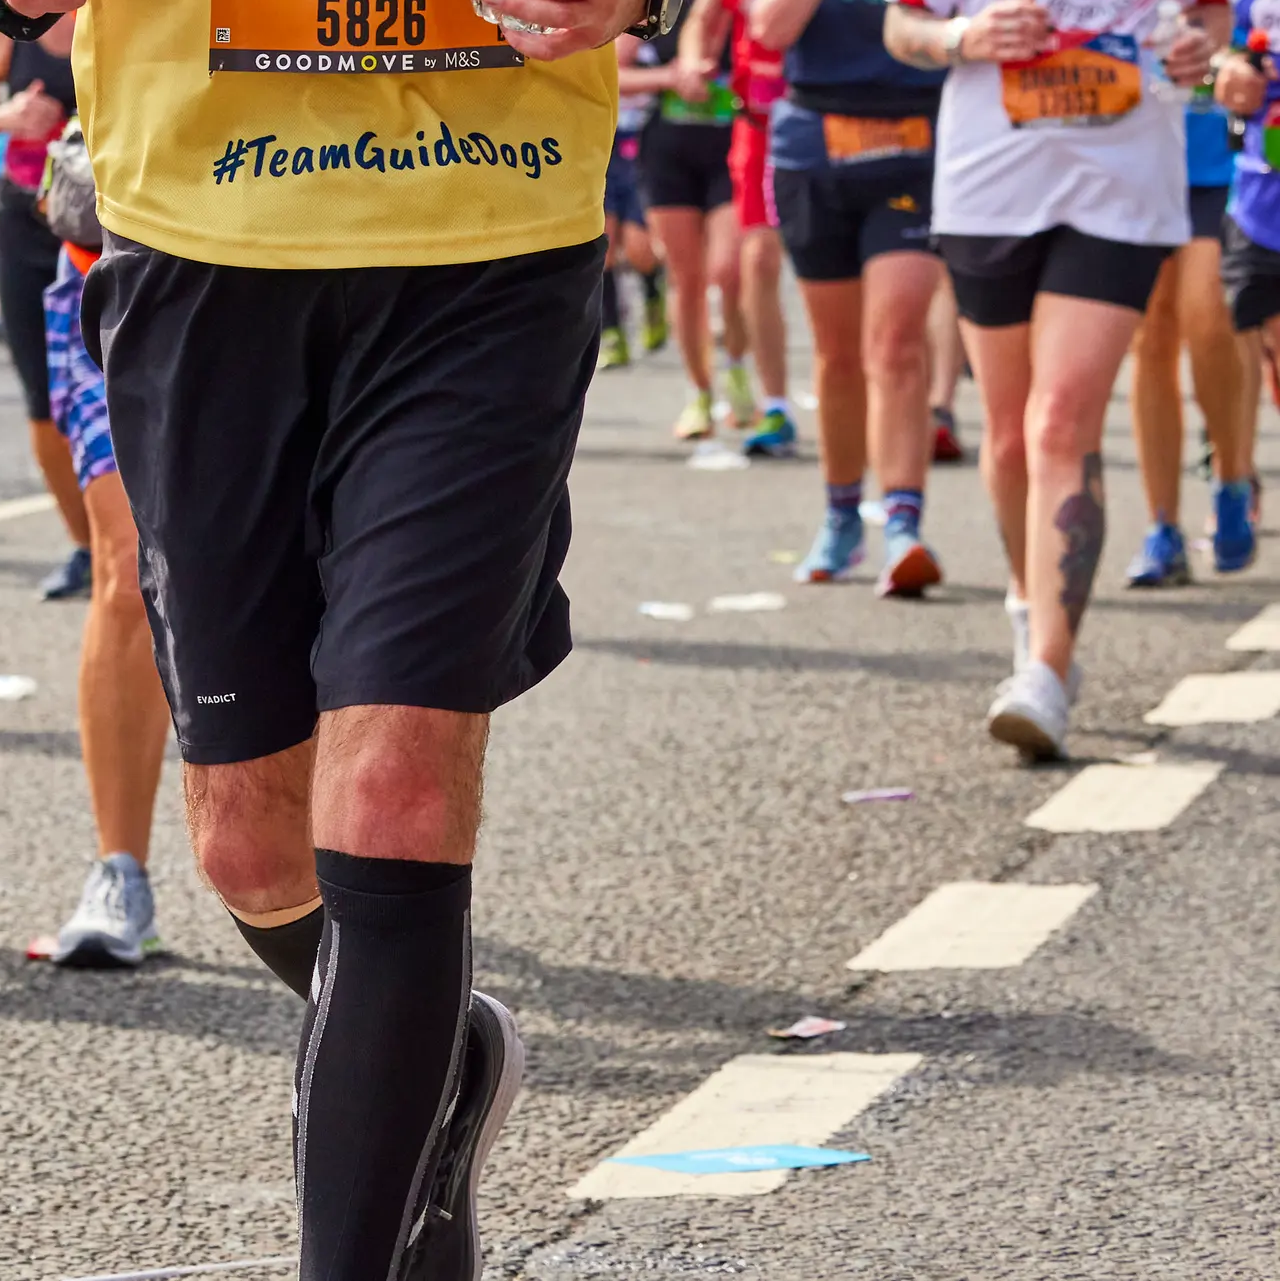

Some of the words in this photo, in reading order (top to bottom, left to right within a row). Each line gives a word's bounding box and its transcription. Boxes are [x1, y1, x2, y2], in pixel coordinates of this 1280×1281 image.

[255, 52, 414, 72] GOODMOVE
[424, 56, 437, 69] by
[444, 50, 480, 68] M&S
[213, 121, 563, 185] #TeamGuideDogs
[196, 692, 236, 704] EVADICT
